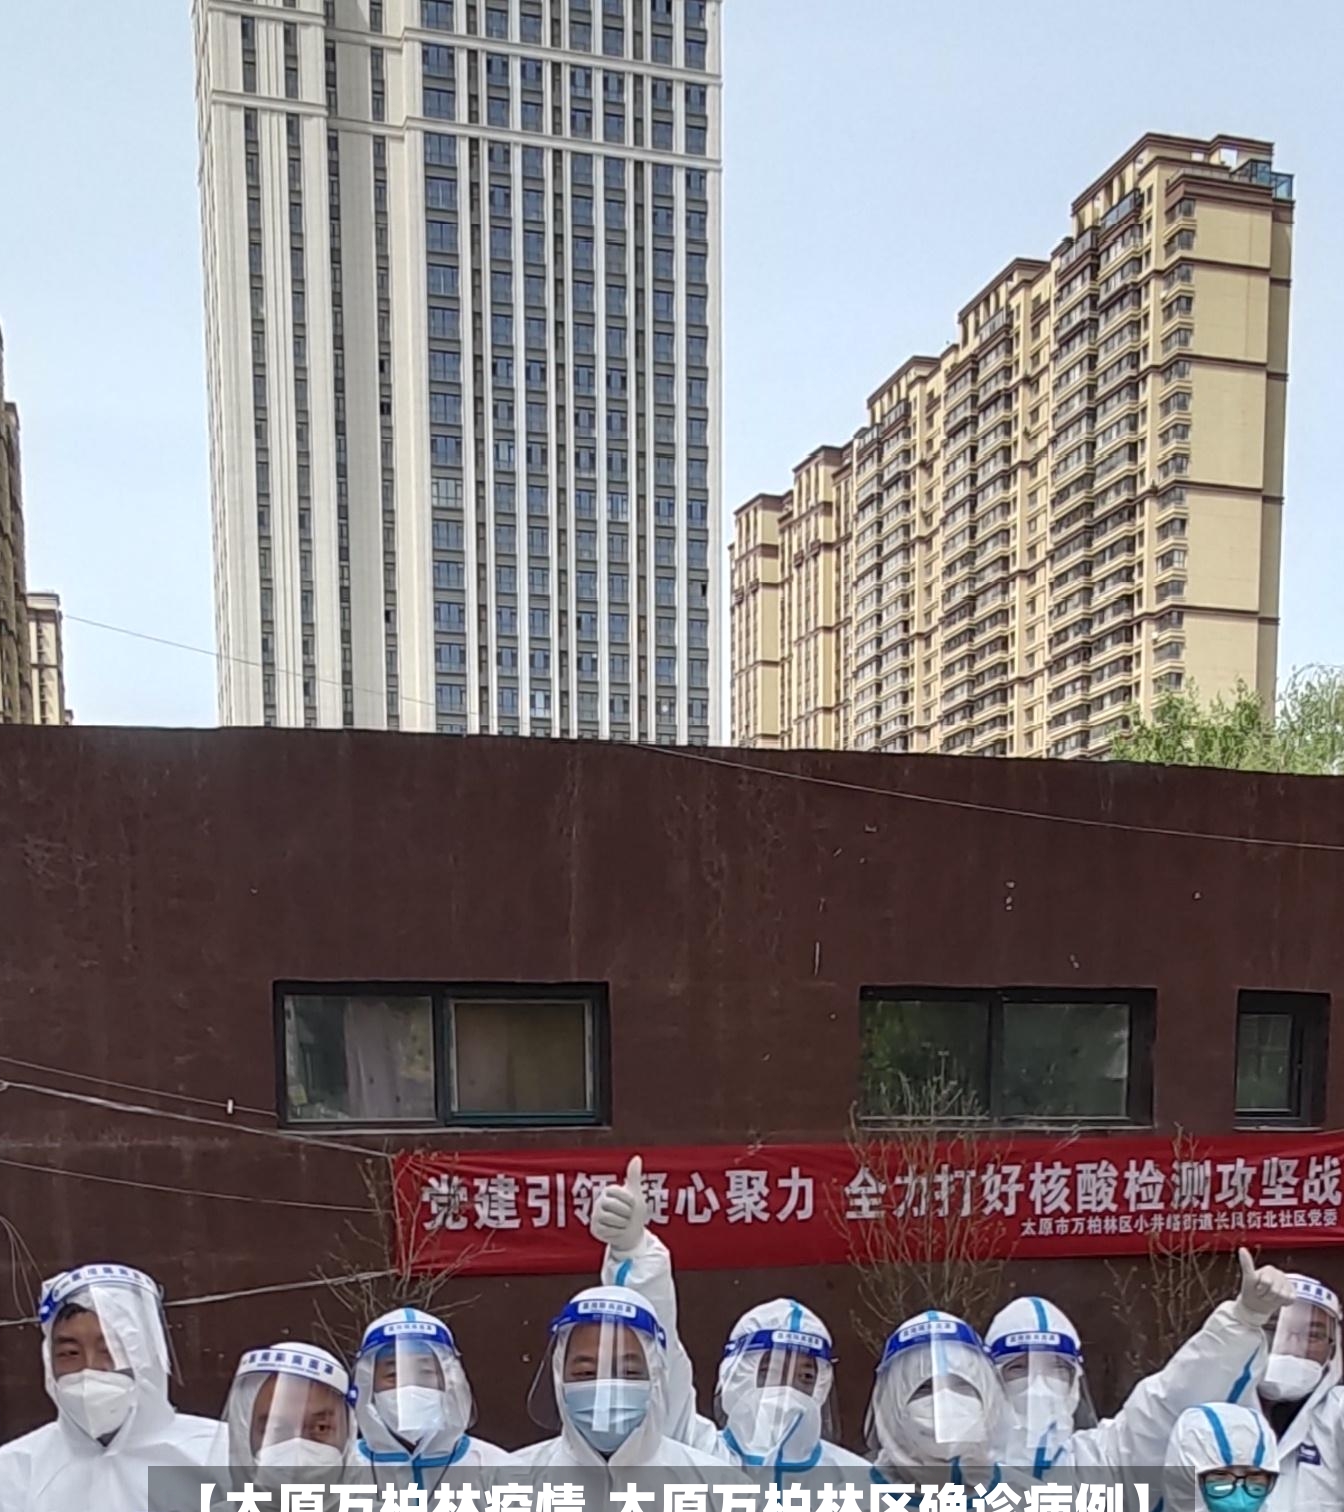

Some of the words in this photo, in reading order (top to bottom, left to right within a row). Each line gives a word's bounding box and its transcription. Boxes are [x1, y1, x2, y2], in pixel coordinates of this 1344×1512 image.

[844, 1156, 1343, 1220] 全力打好核酸检测攻坚战
